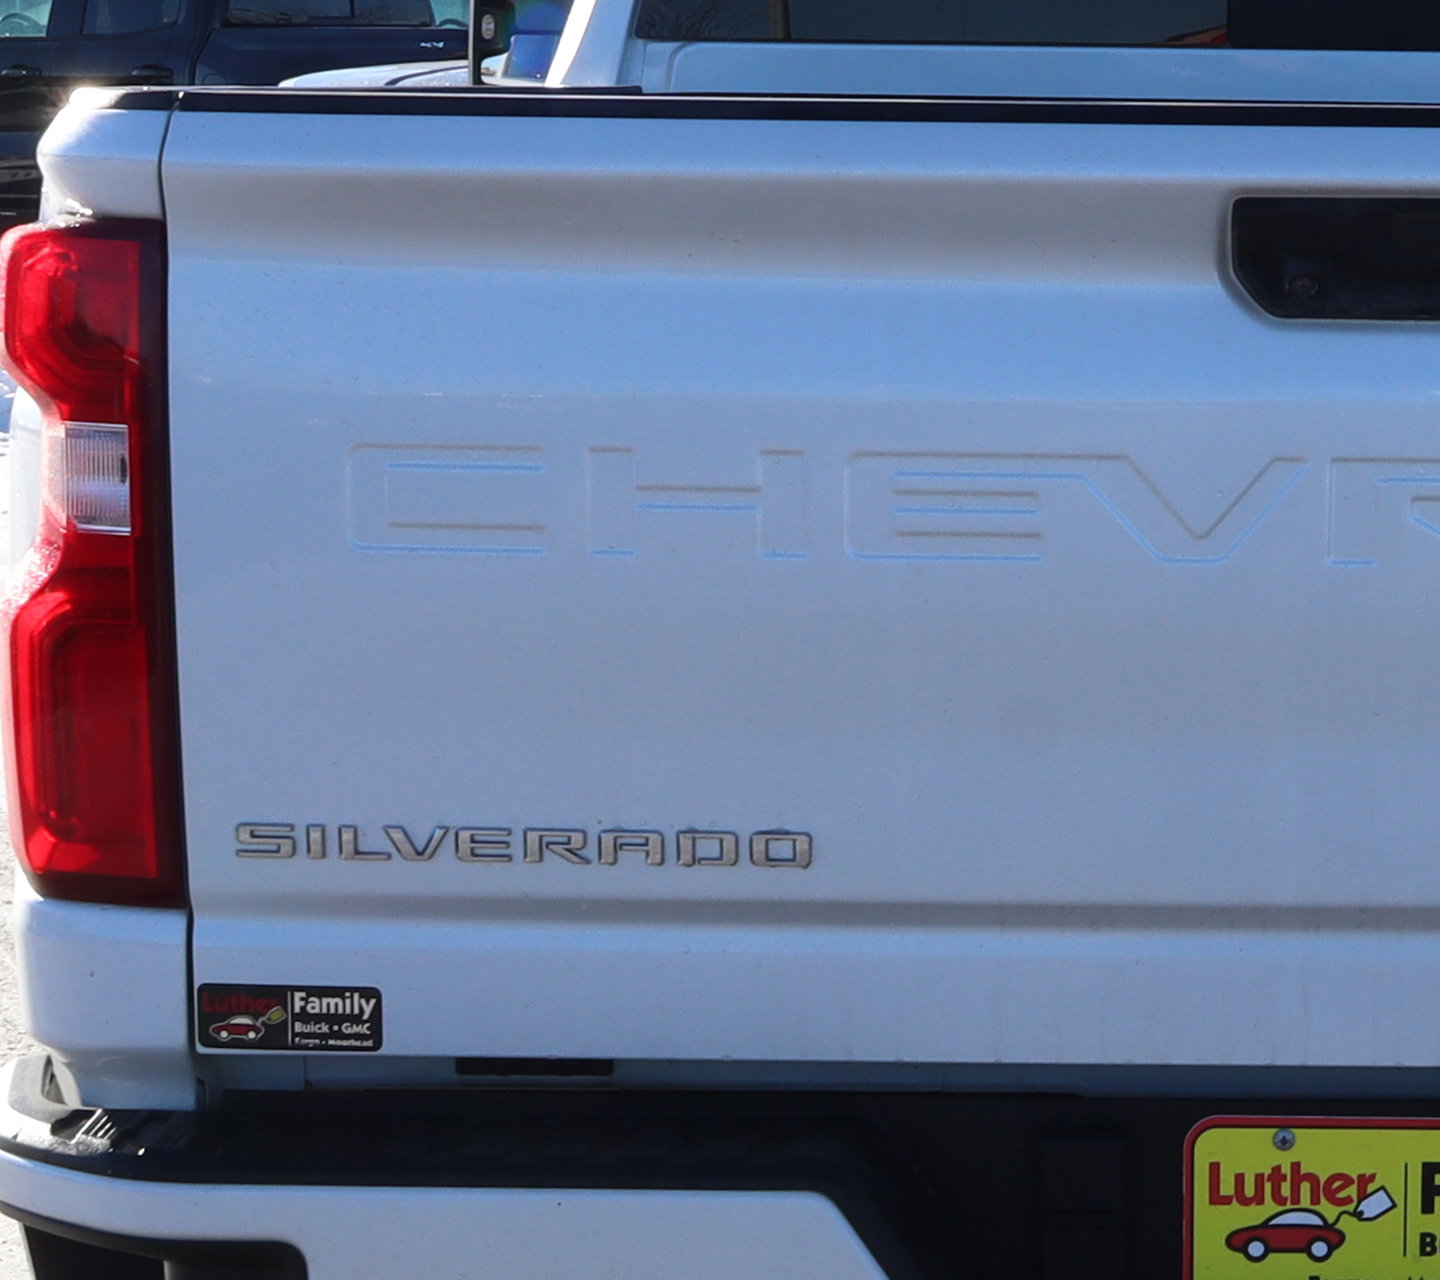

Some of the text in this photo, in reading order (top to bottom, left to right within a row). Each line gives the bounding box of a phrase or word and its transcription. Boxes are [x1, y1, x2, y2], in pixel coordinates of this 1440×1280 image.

[235, 822, 815, 869] SILVERADO
[201, 991, 282, 1014] Luther
[293, 991, 376, 1020] Family
[294, 1021, 371, 1035] Buick GMC
[1208, 1161, 1377, 1207] Luther
